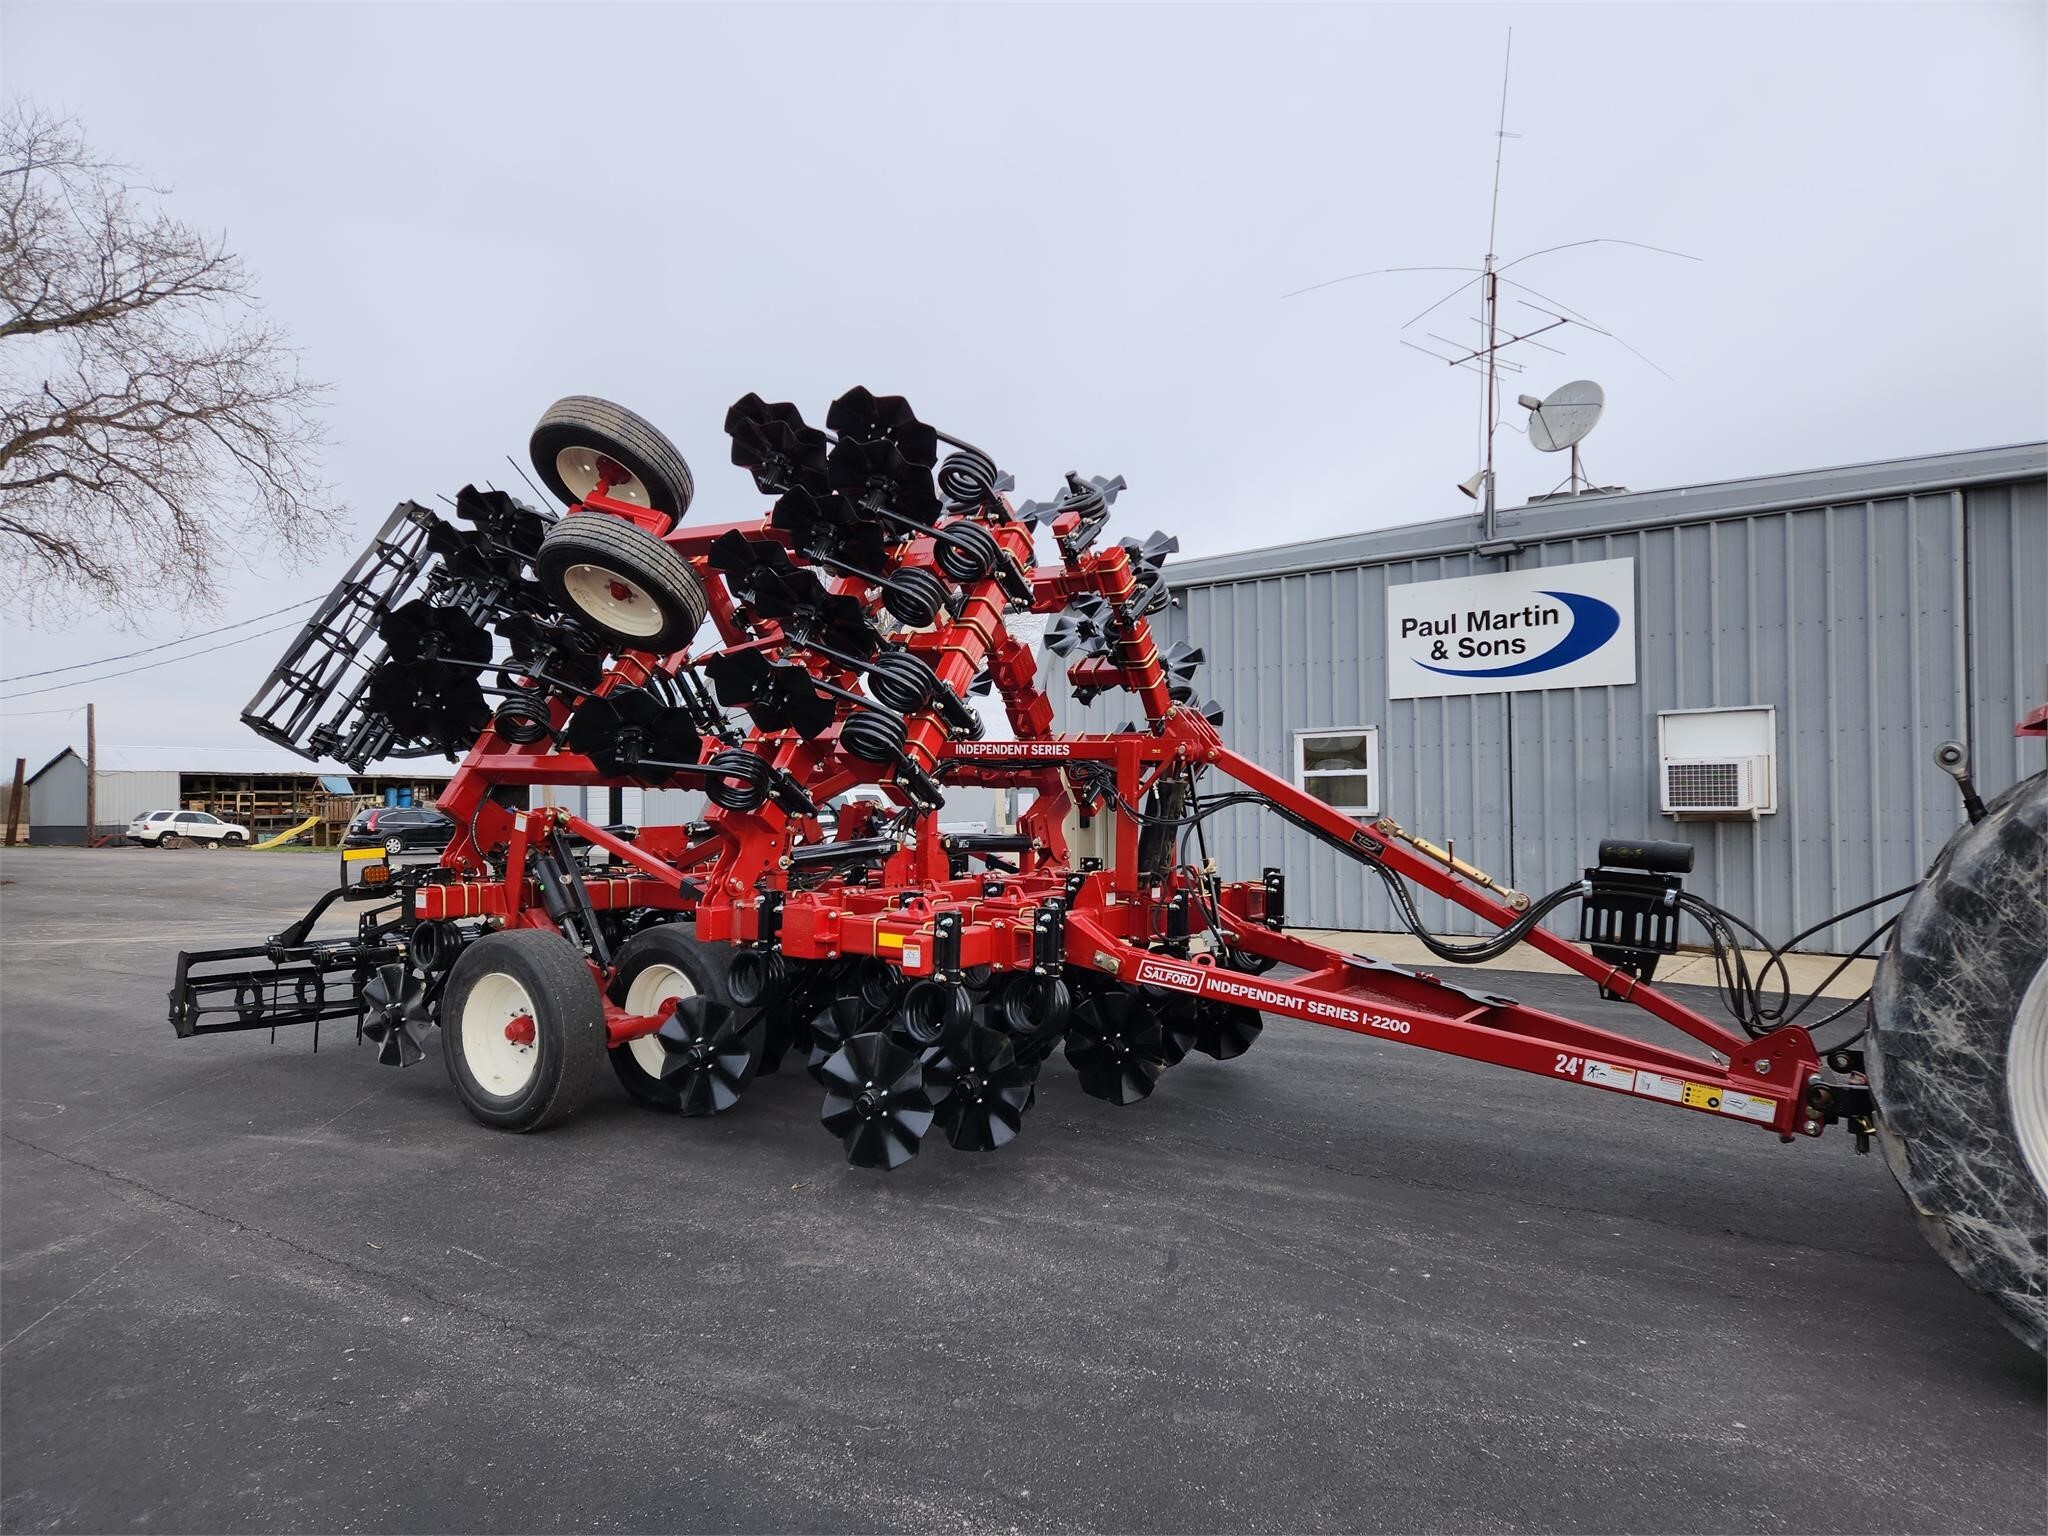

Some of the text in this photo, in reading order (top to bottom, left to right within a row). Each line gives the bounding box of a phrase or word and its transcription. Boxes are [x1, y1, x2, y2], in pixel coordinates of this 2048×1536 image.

[1401, 605, 1559, 639] Paul Martin
[1430, 637, 1526, 661] & Sons
[955, 744, 1070, 756] INDEPENDENT SERIES
[1142, 965, 1199, 988] SALFORD
[1206, 978, 1411, 1034] INDEPENDENT SERIES I-2200
[1554, 1054, 1583, 1076] 24'
